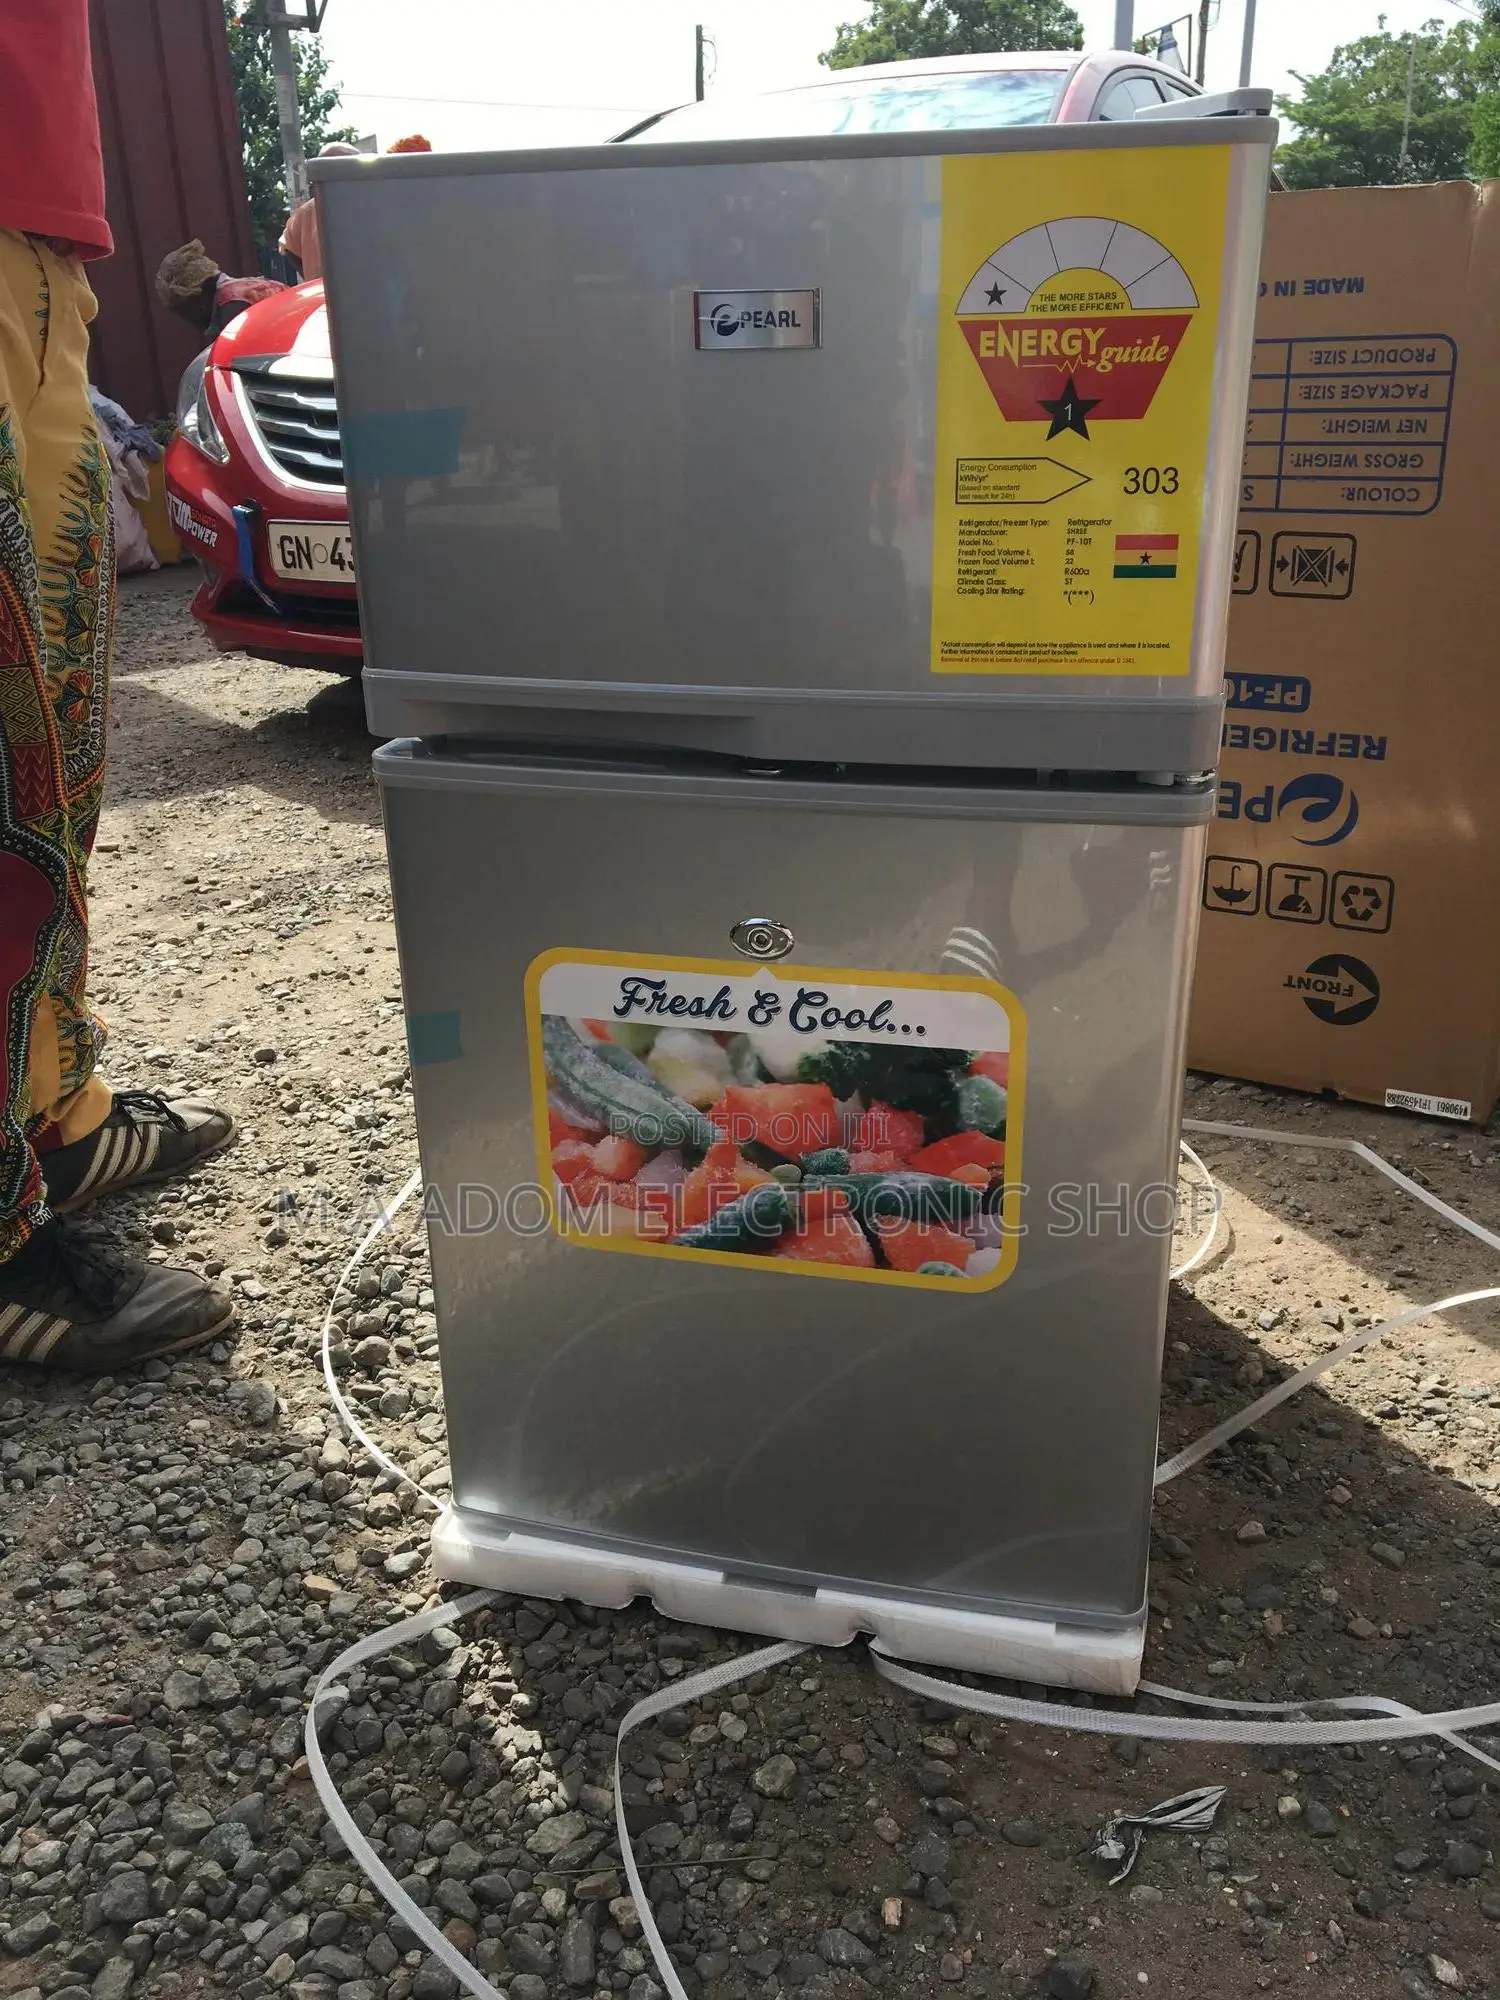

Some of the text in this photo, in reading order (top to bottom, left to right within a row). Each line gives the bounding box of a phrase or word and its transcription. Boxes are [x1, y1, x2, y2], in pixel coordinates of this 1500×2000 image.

[1275, 280, 1296, 297] IN
[1304, 277, 1364, 295] MADE
[1039, 291, 1117, 302] THE MORE STARS
[1030, 302, 1125, 312] THE MORE EFFICIENT
[740, 310, 801, 329] PEARL
[979, 320, 1169, 372] ENERGY guide
[1309, 347, 1437, 365] PRODUCT SIZE:
[1299, 383, 1430, 400] PACKAGE SIZE:
[1064, 403, 1073, 421] 1
[1322, 419, 1428, 434] NET WEIGHT:
[960, 463, 1037, 473] Energy Consumption
[1289, 453, 1424, 468] GROSS WEIGHT:
[1123, 467, 1180, 494] 303
[1340, 487, 1420, 502] COLOUR:
[1030, 519, 1050, 528] Type:
[1067, 518, 1112, 526] Refrigerator
[187, 522, 217, 547] POWER
[279, 535, 314, 570] GN
[977, 548, 996, 556] Food
[958, 558, 980, 566] Frozen
[982, 558, 1000, 566] Food
[1001, 558, 1030, 566] Volume
[1064, 568, 1090, 576] R600a
[957, 578, 984, 586] Climate
[957, 587, 985, 595] Cooling
[986, 587, 1000, 595] Star
[1221, 723, 1387, 761] REFRIGE
[1218, 781, 1274, 823] PE
[1282, 975, 1355, 998] FRONT
[613, 976, 926, 1034] Fresh & Cool...
